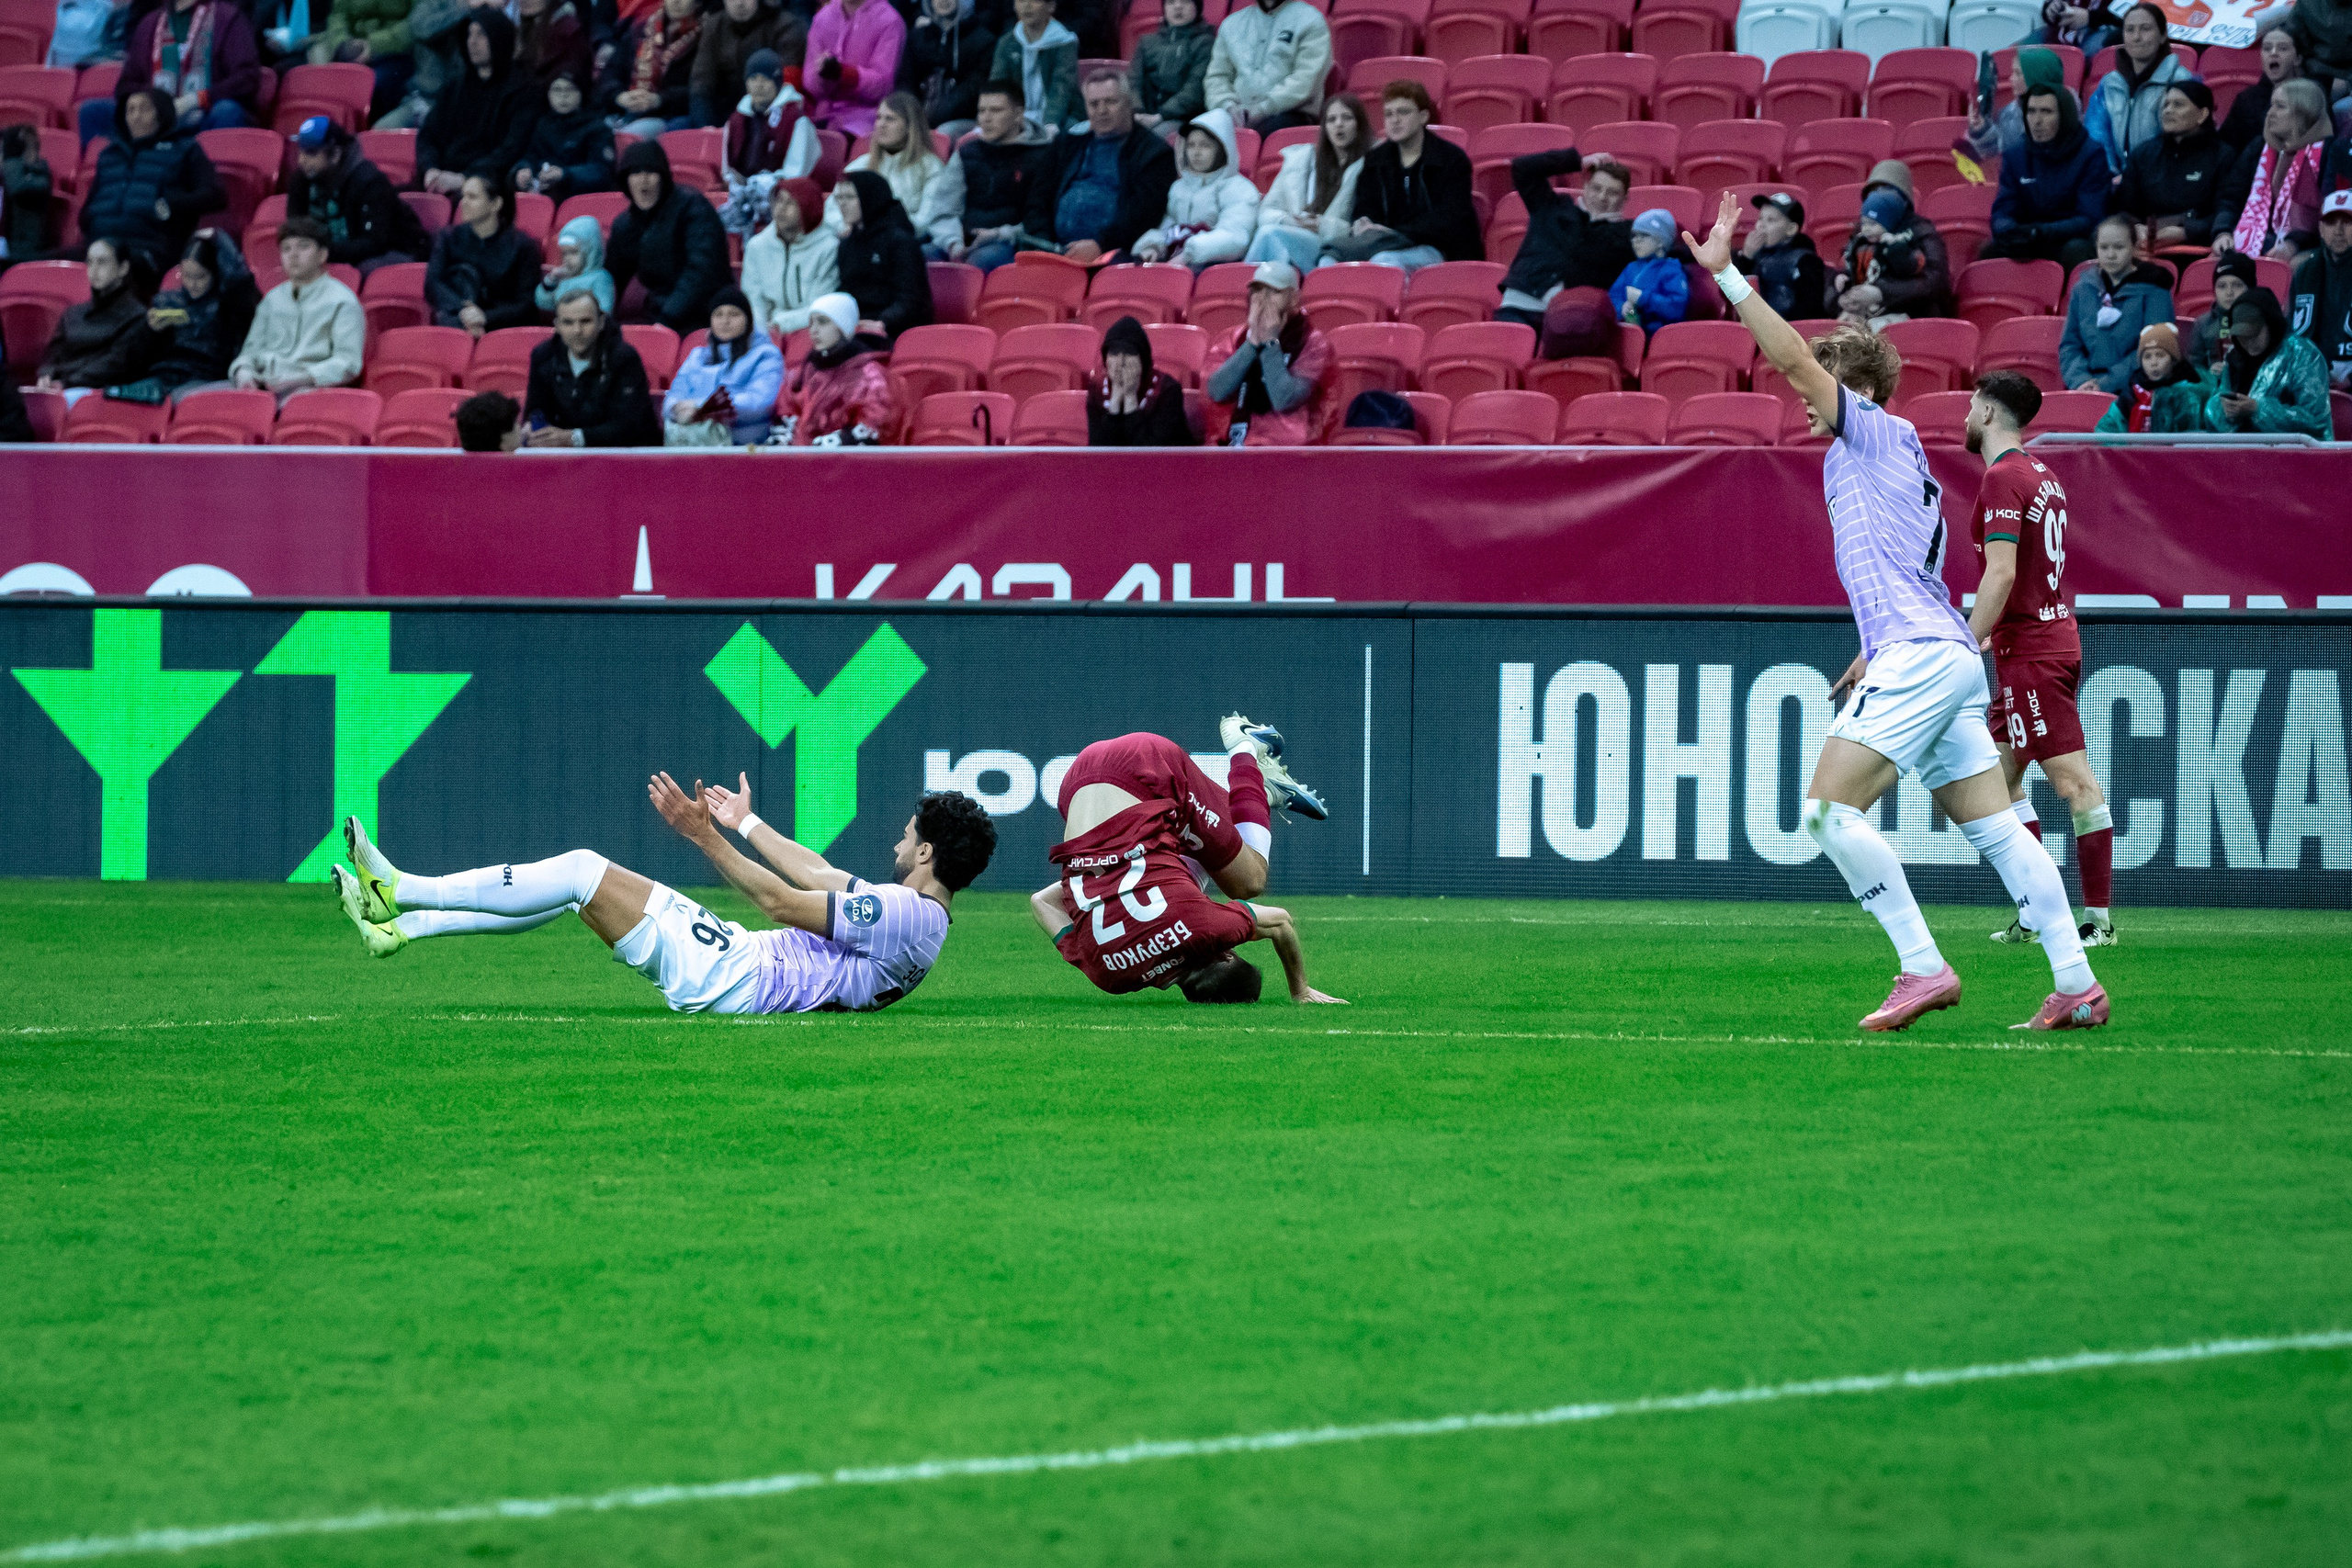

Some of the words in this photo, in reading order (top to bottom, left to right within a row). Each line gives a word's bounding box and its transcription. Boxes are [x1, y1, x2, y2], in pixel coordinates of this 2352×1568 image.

[1497, 660, 2352, 868] ЮНОСКА
[1102, 919, 1193, 971] БЕЗРУКОВ
[1142, 956, 1185, 982] FONBET
